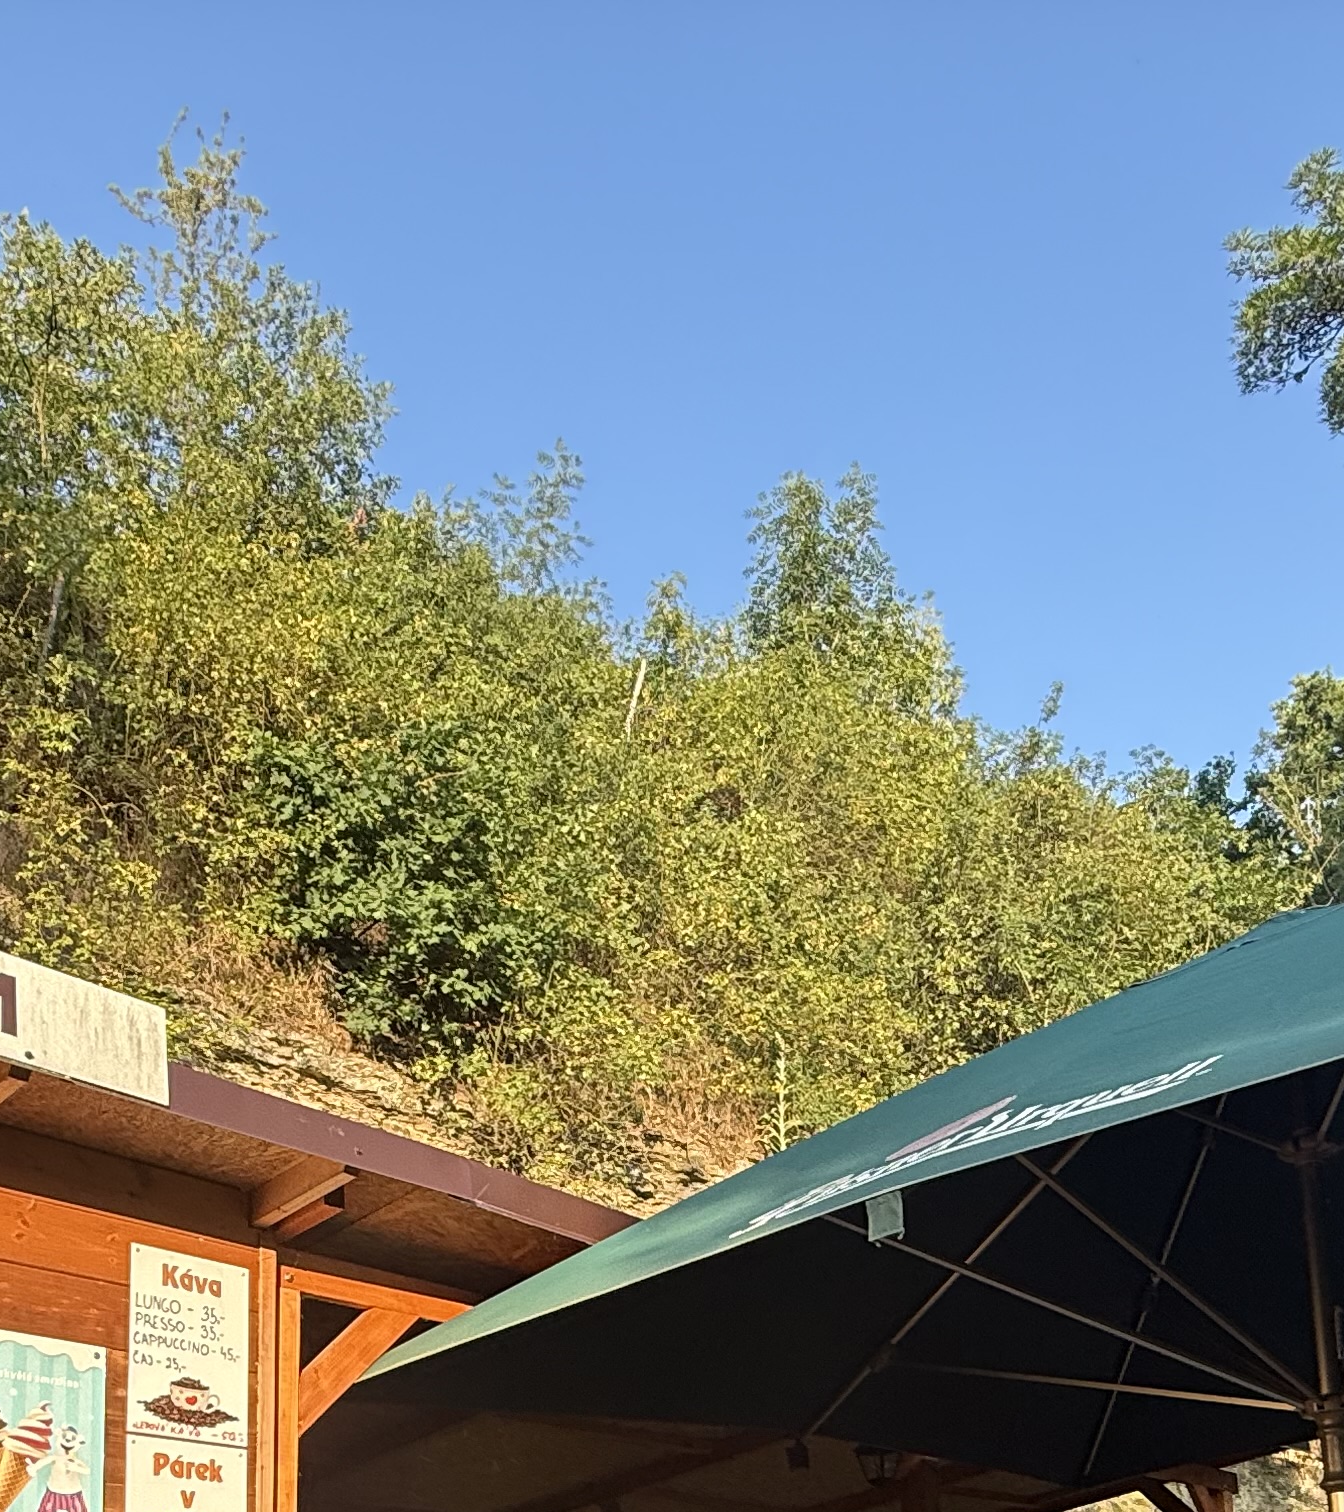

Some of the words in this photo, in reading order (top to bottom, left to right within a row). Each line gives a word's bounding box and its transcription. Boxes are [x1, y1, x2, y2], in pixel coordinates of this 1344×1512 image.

[161, 1262, 222, 1299] Káva
[134, 1291, 182, 1315] LUNGO
[200, 1305, 226, 1325] 35,-
[134, 1311, 186, 1334] PRESSO
[200, 1324, 225, 1342] 35,-
[132, 1330, 210, 1357] CAPPUCCINO
[152, 1452, 224, 1484] Párek
[179, 1489, 196, 1509] v
